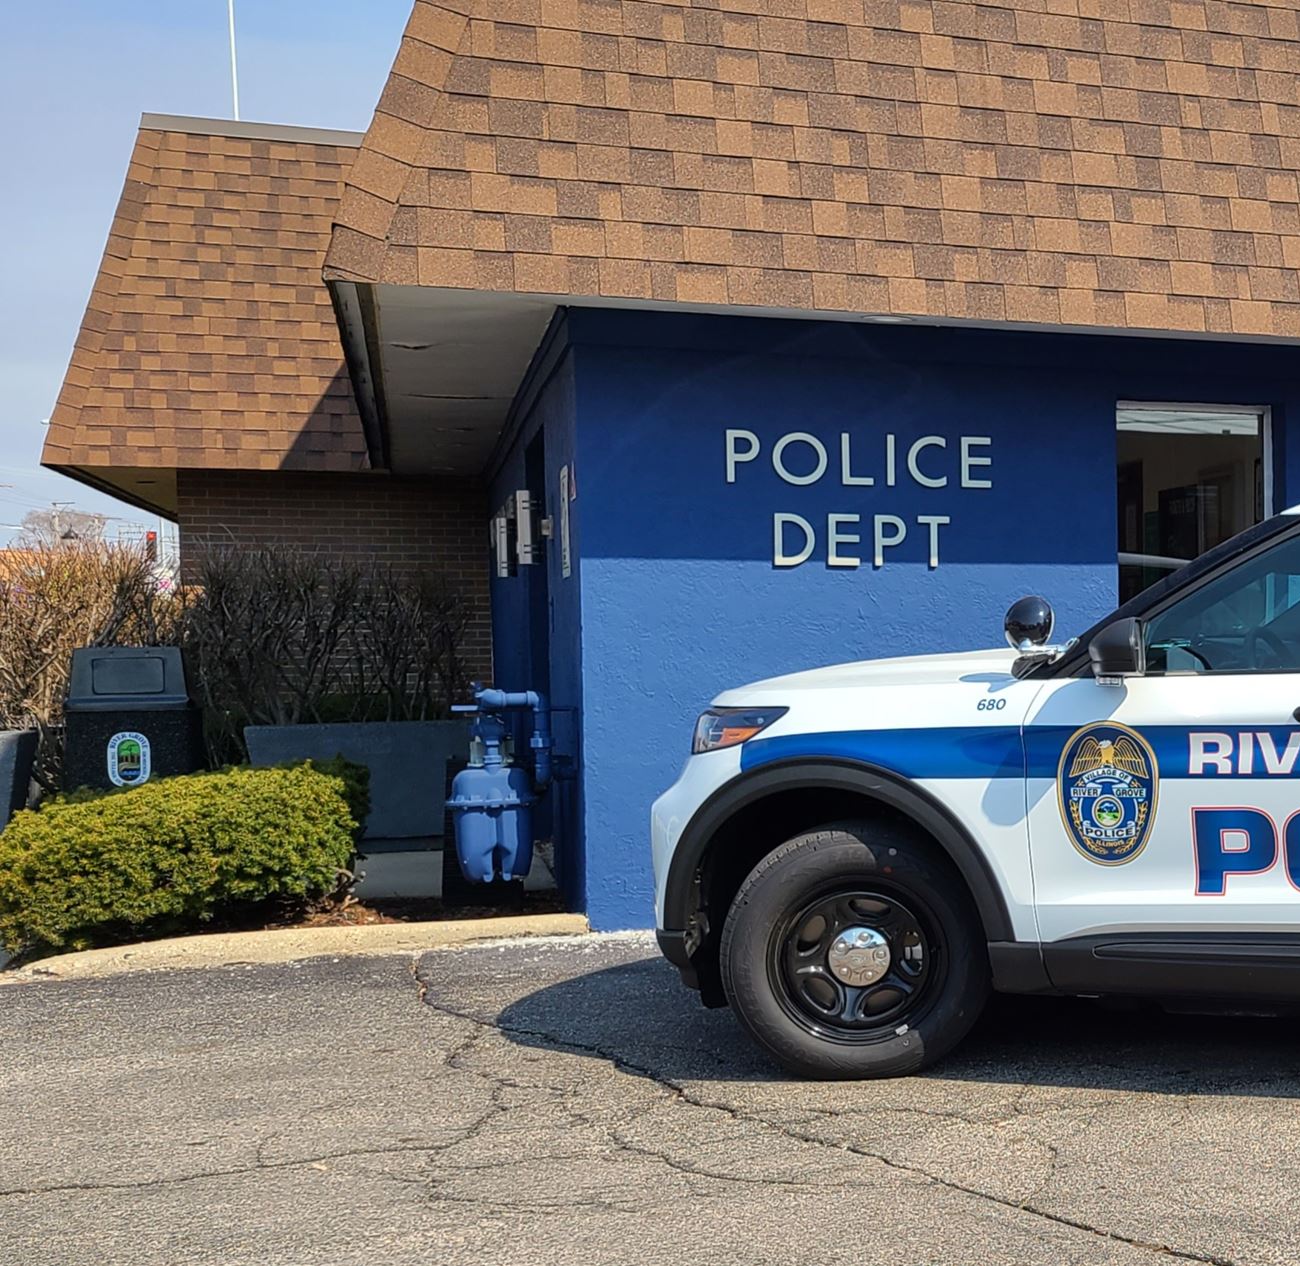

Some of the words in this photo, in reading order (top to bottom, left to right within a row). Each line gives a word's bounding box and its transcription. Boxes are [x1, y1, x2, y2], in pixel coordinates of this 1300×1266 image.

[726, 429, 992, 488] POLICE
[773, 512, 950, 567] DEPT
[977, 698, 1006, 711] 680
[1085, 769, 1117, 780] VILLAGE
[1072, 788, 1098, 796] RIVER
[1115, 789, 1144, 797] GROVE
[1085, 828, 1133, 837] POLICE
